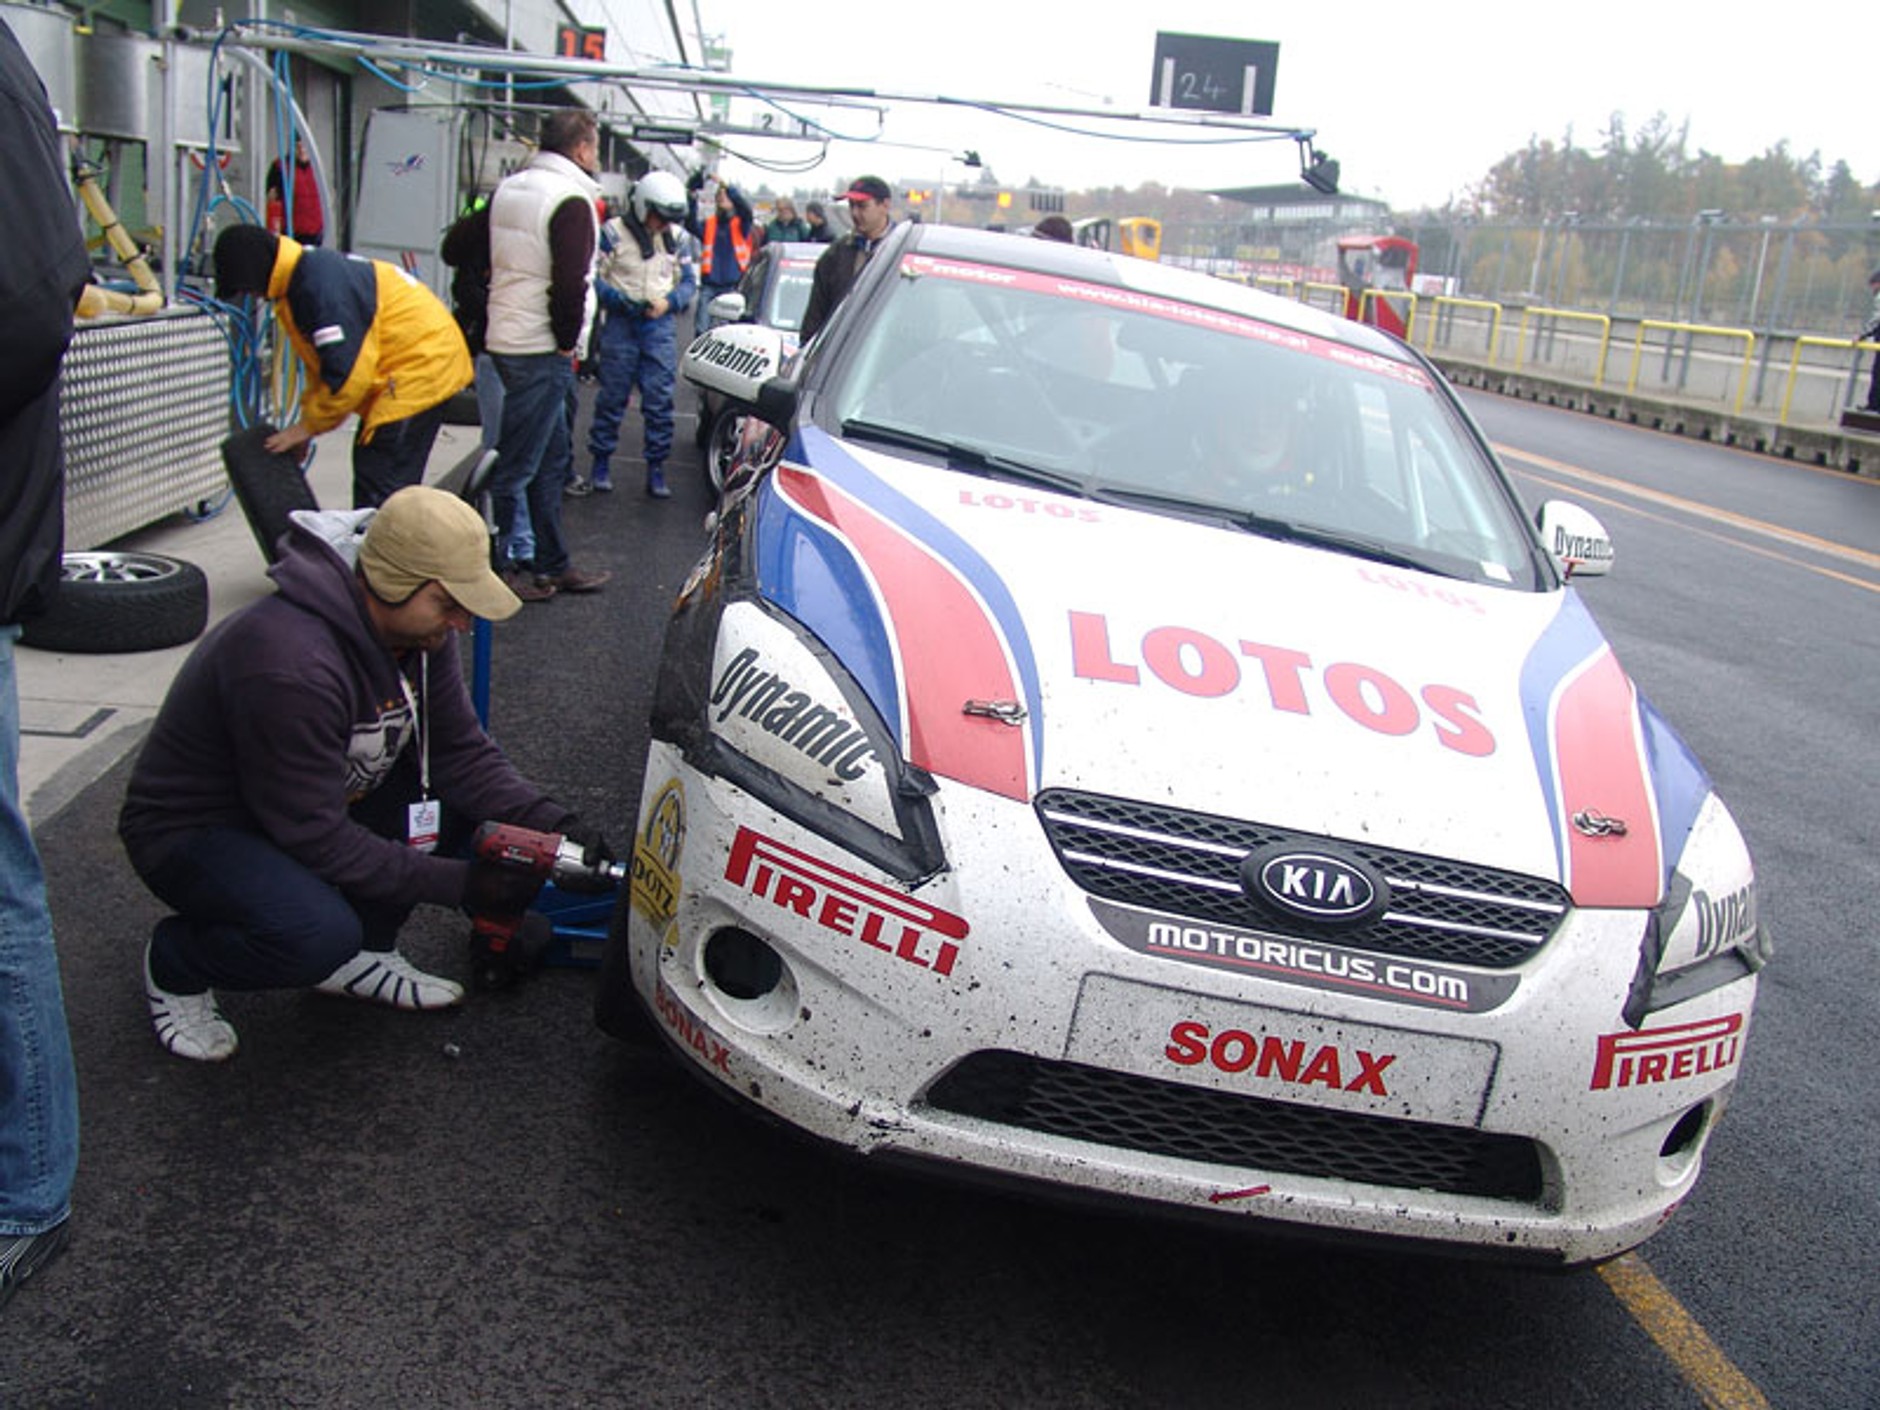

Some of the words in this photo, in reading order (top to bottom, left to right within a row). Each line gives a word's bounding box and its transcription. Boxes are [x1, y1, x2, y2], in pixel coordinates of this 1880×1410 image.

[560, 29, 605, 59] 15
[1180, 72, 1227, 99] 24
[689, 331, 770, 378] Dynamic
[959, 491, 1104, 523] LOTOS
[711, 647, 875, 781] Dynamic
[1067, 609, 1497, 758] LOTOS
[724, 825, 970, 976] PIRELLI
[1282, 864, 1356, 905] KIA
[1692, 882, 1755, 957] Dyna
[1149, 923, 1469, 1002] MOTORICUS.COM
[1165, 1020, 1397, 1097] SONAX
[1589, 1013, 1743, 1090] PIRELLI
